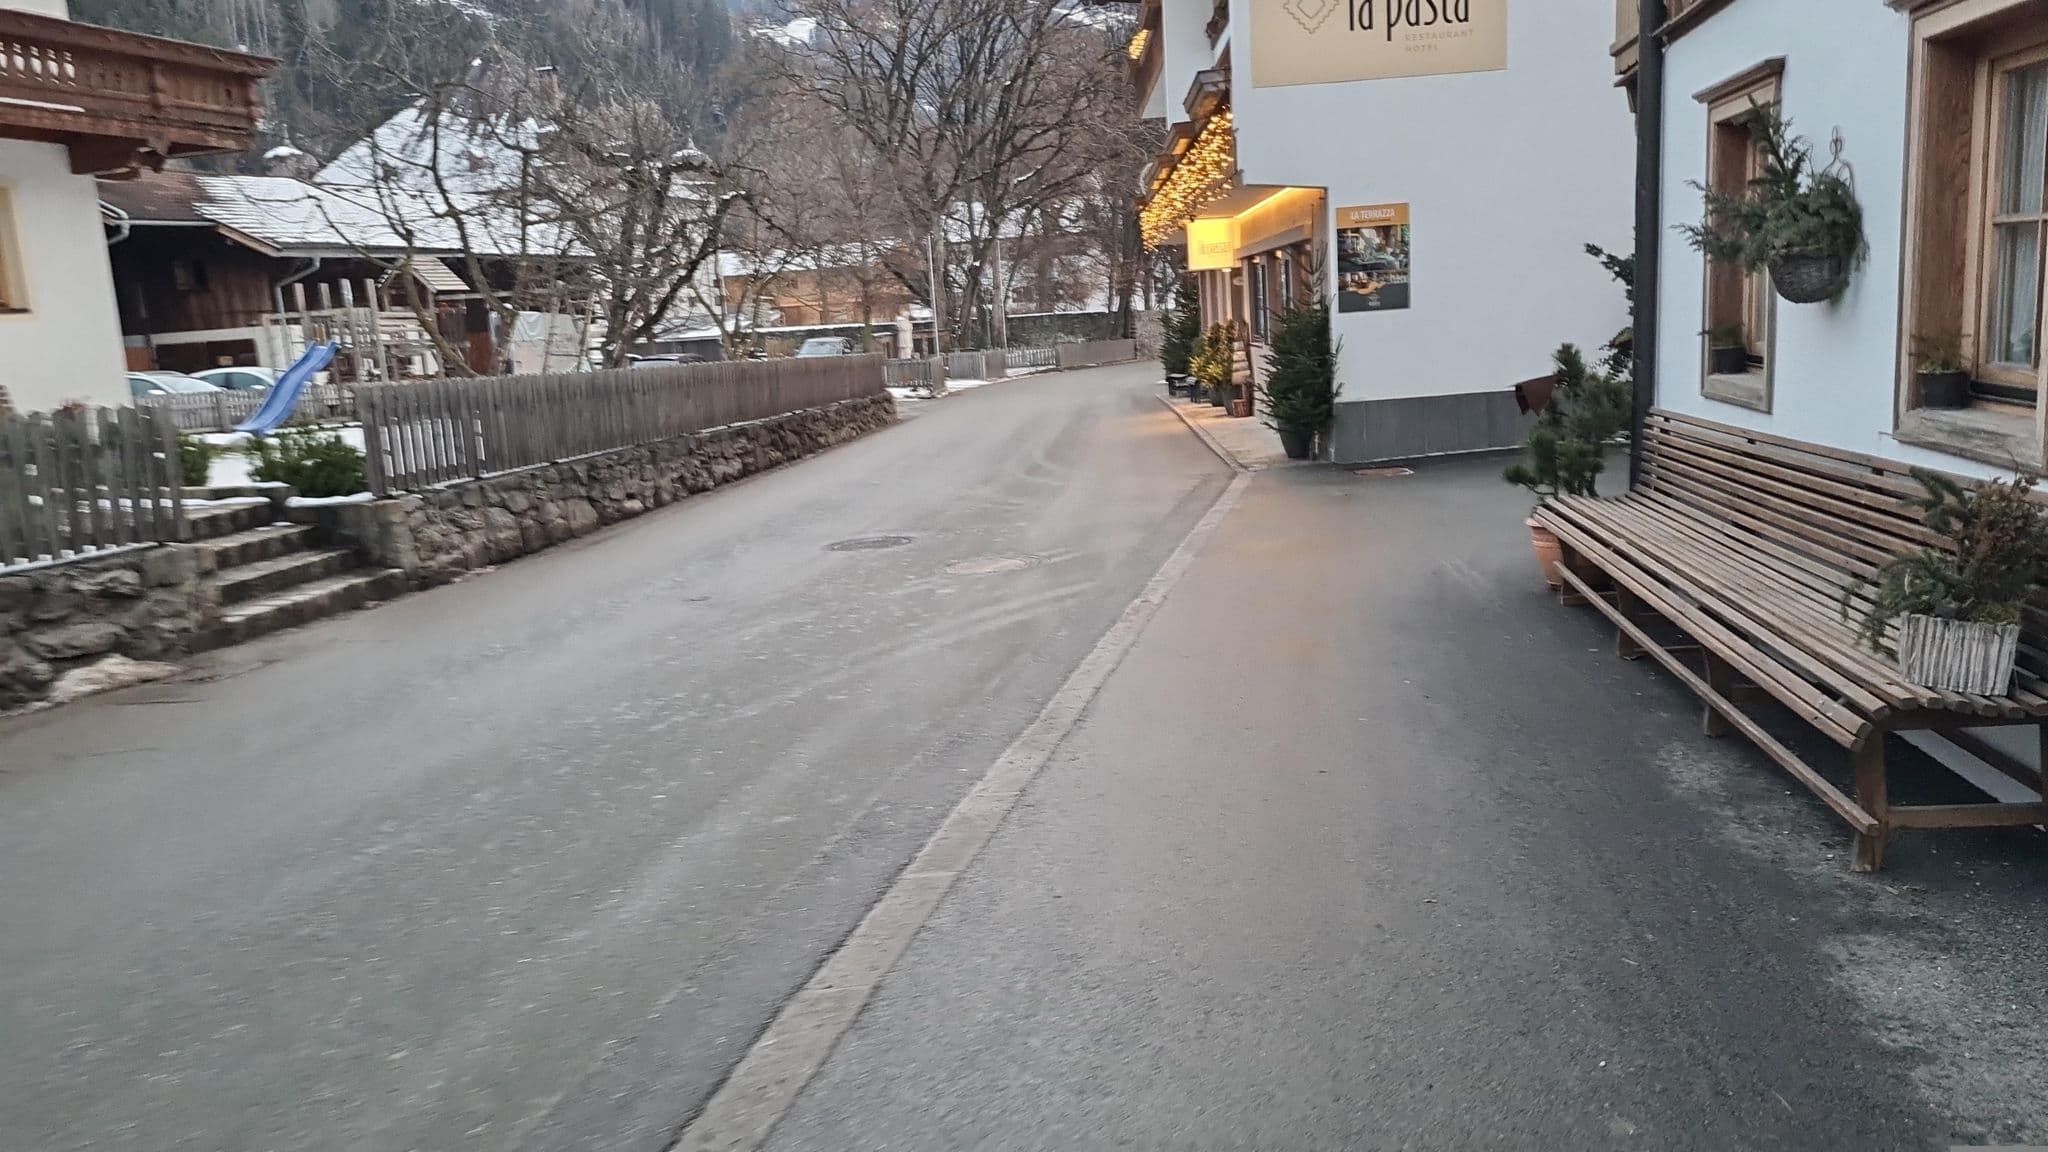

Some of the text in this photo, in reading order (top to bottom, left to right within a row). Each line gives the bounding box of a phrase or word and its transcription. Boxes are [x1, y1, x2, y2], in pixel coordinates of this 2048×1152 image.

[1349, 0, 1374, 31] la
[1404, 30, 1473, 41] RESTAURANT
[1351, 208, 1395, 219] LA TERRAZZA
